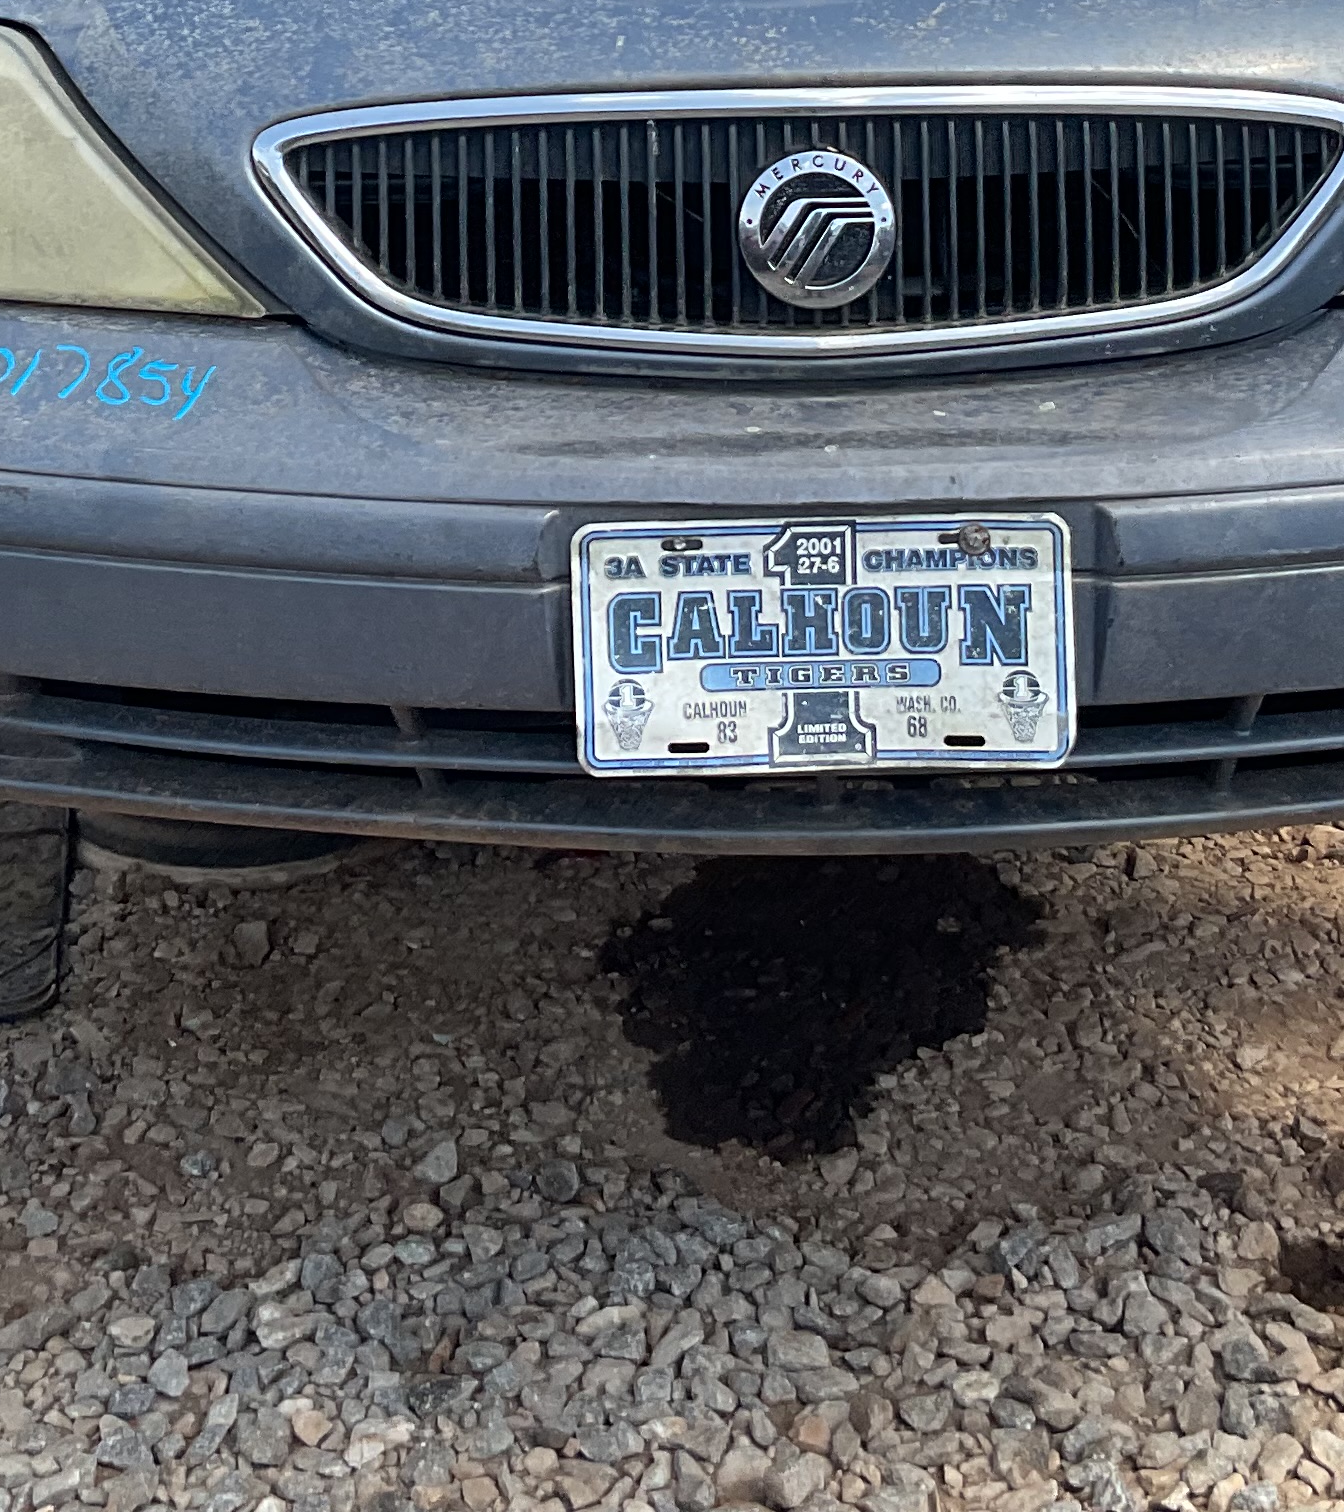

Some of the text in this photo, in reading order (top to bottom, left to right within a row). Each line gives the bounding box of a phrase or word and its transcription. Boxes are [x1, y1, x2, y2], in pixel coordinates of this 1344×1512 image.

[754, 154, 880, 199] MERCURY
[797, 536, 842, 556] 2001
[605, 552, 752, 579] 3A STATE
[797, 555, 840, 575] 27-6
[862, 547, 1039, 573] CHAMPIONS
[608, 583, 1033, 675] CALHOUN
[730, 663, 911, 688] TIGERS
[682, 700, 748, 721] CALHOUN
[717, 721, 739, 744] 83
[797, 723, 847, 734] LIMITED
[906, 715, 928, 738] 68
[798, 733, 847, 744] EDITION
